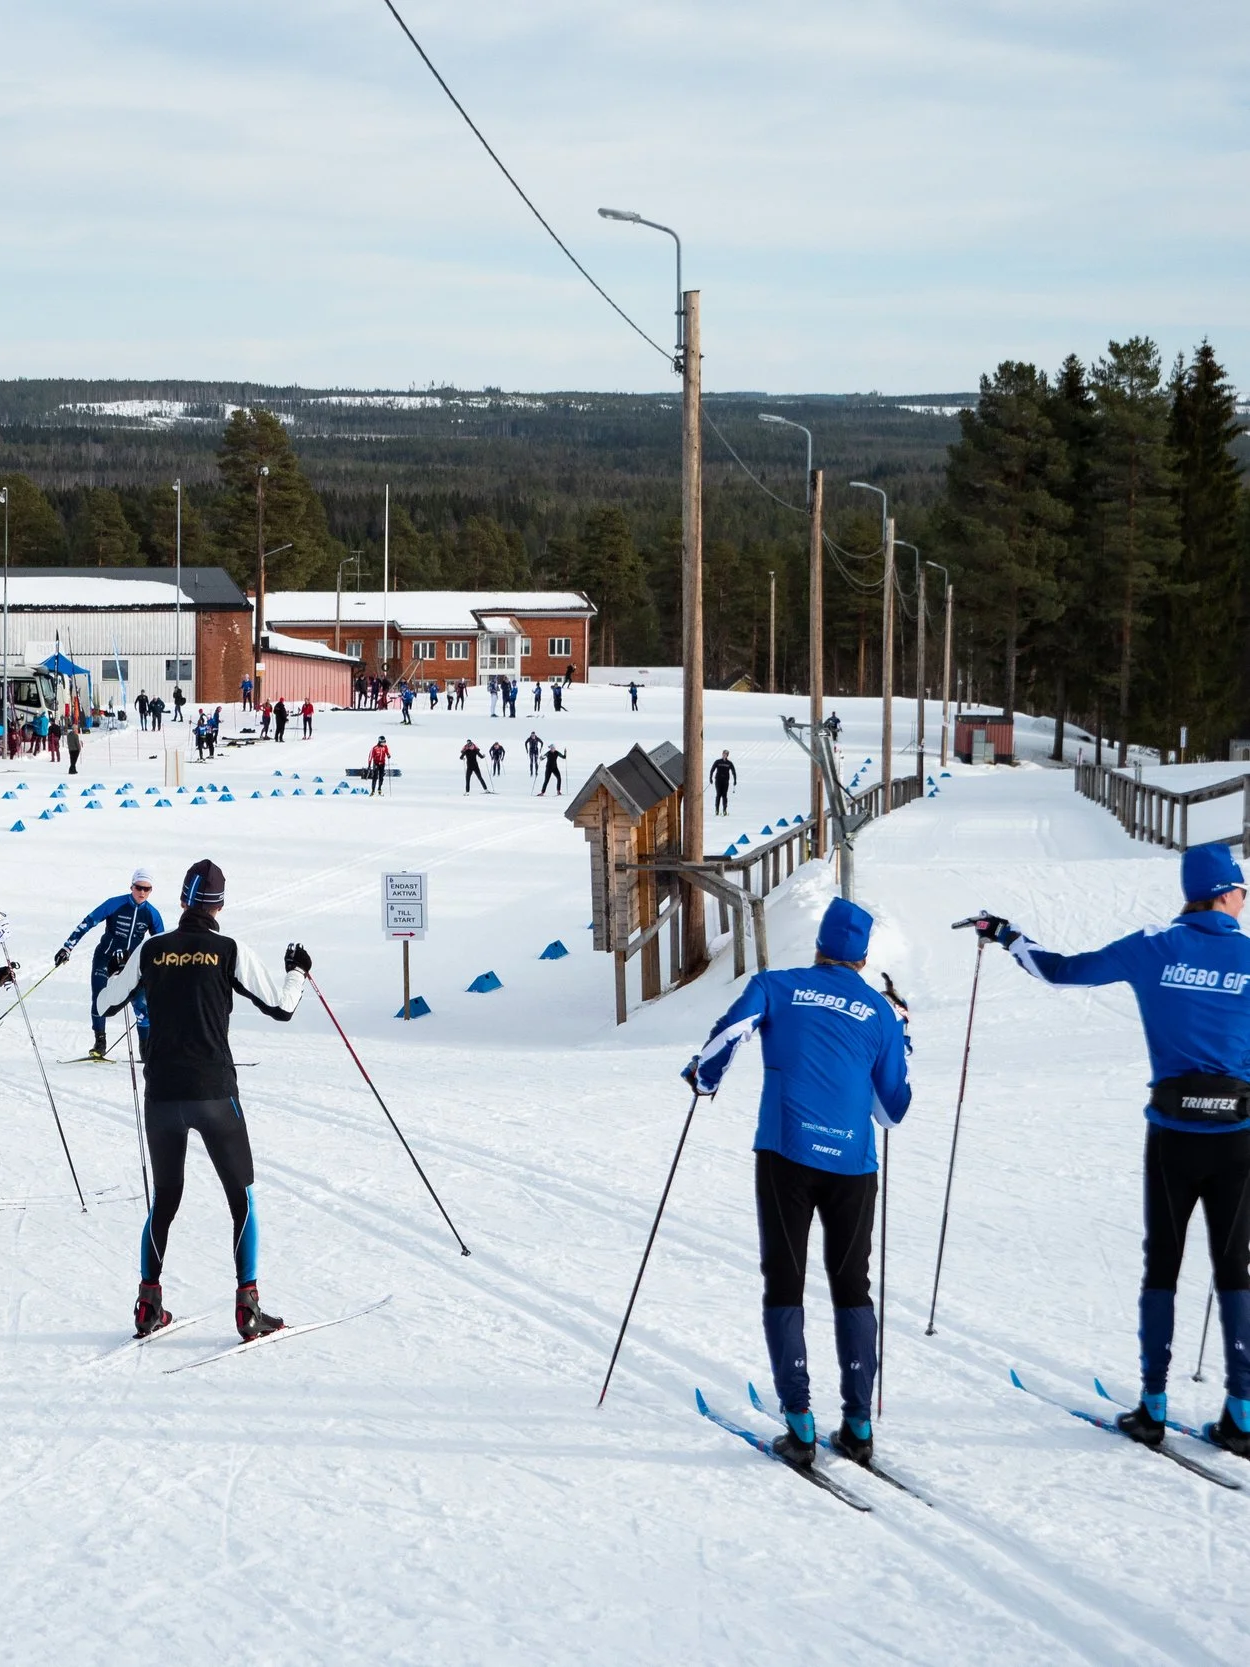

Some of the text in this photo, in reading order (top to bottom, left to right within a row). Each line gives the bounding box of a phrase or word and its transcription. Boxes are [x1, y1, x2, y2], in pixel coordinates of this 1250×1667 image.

[153, 951, 219, 967] JAPAN
[1161, 962, 1250, 994] HÖGBO GIF
[793, 989, 876, 1021] HÖGBO GIF
[1181, 1096, 1238, 1111] TRIMTEX
[812, 1143, 842, 1157] TRIMTEX
